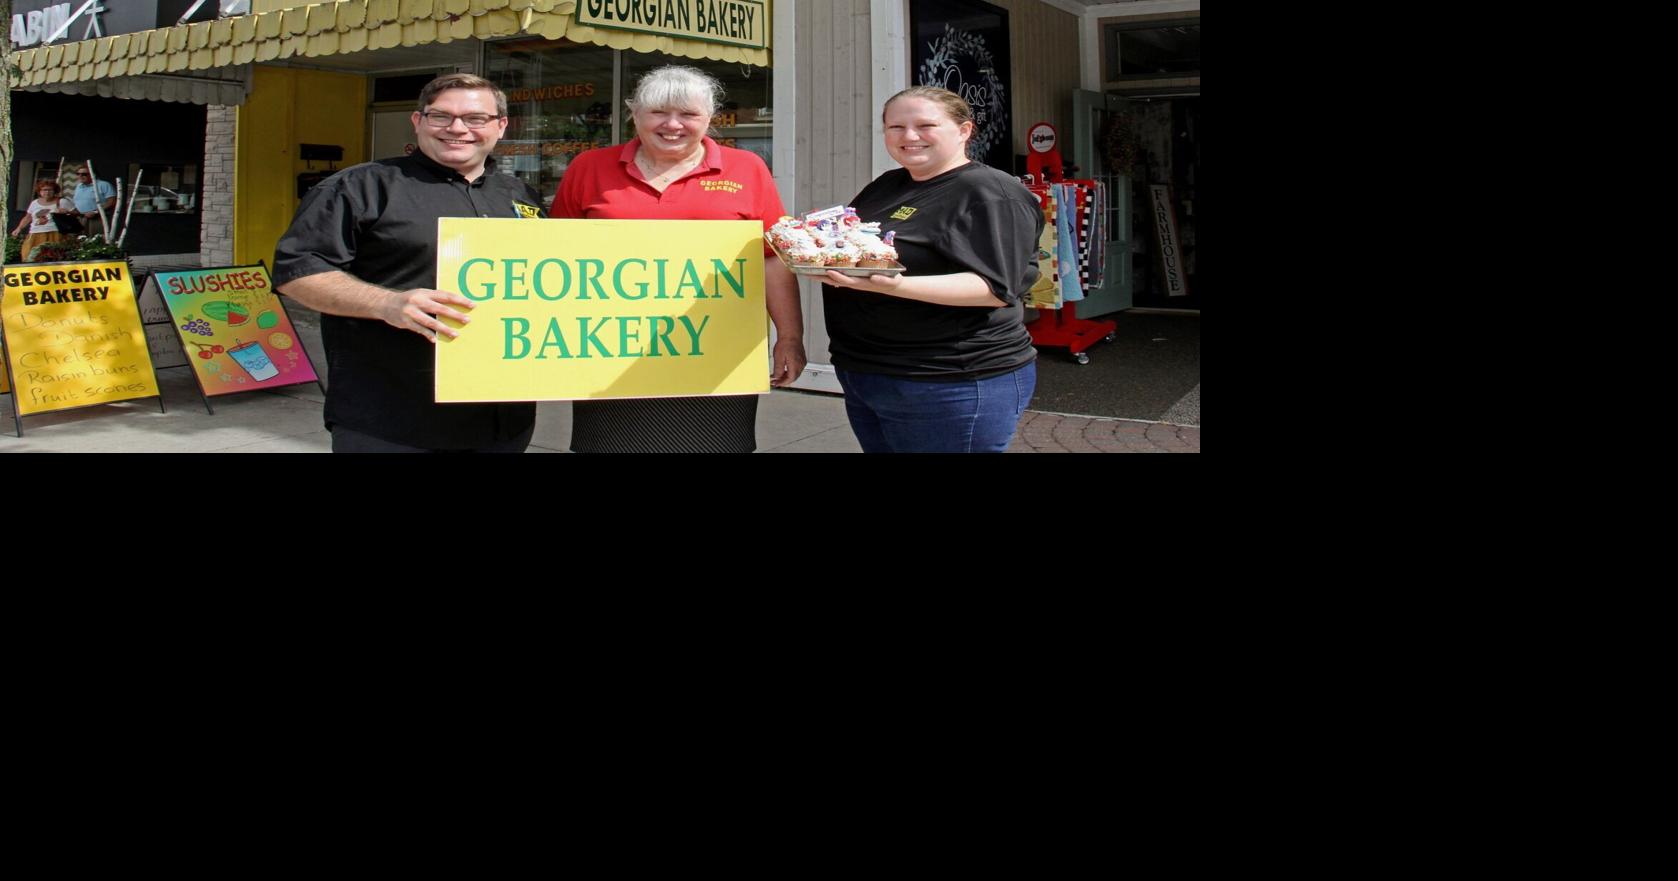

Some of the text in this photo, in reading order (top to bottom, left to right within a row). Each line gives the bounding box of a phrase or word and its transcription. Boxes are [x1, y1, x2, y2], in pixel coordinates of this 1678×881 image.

[10, 3, 71, 46] ABIN
[587, 0, 754, 40] GEORGIAN BAKERY
[506, 83, 594, 101] NDWICHES
[700, 180, 743, 190] GEORGIAN
[704, 185, 738, 194] BAKERY
[1154, 189, 1180, 291] FARMHOUSE
[4, 267, 122, 287] GEORGIAN
[168, 271, 267, 295] SLUSHIES
[458, 257, 747, 301] GEORGIAN
[22, 286, 110, 306] BAKERY
[9, 310, 108, 333] Donuts
[500, 314, 710, 360] BAKERY
[20, 348, 121, 368] Chelsea
[19, 364, 139, 385] Raisin buns
[30, 382, 147, 404] fruit scones
